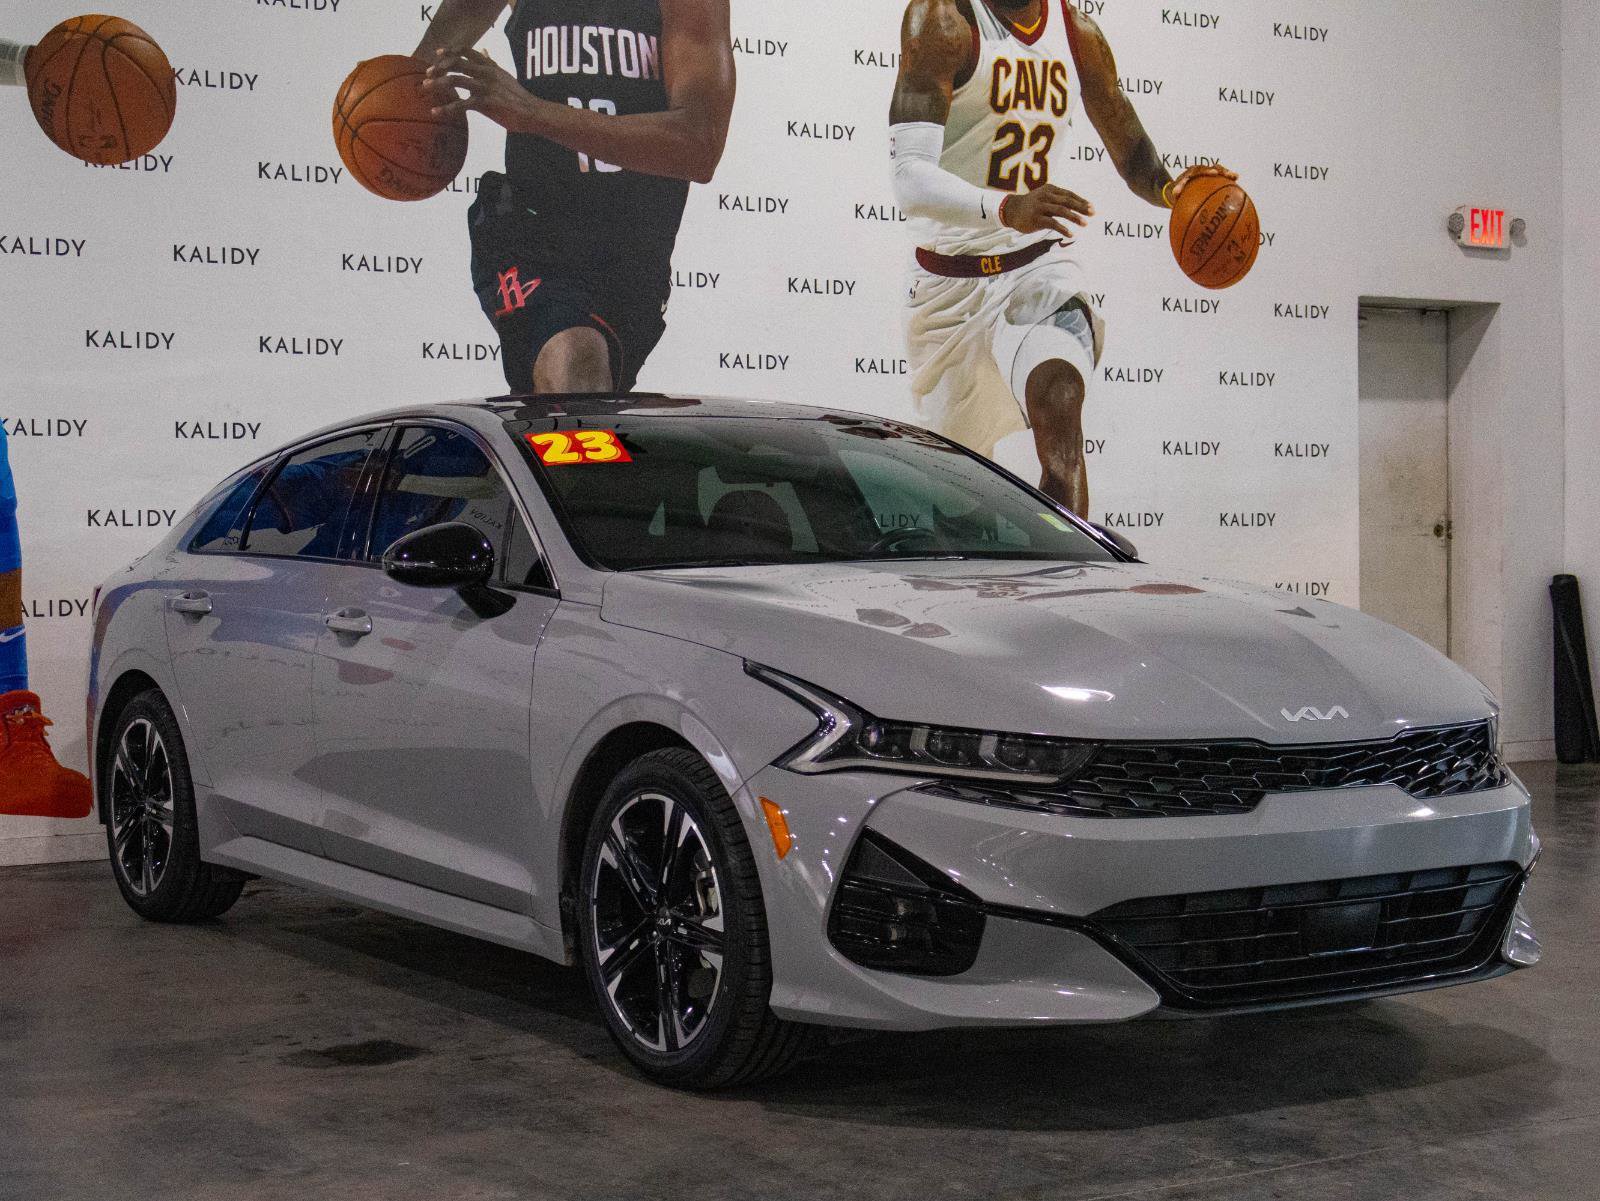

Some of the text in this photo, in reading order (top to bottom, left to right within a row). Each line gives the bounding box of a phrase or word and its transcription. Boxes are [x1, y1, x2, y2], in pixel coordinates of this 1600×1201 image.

[1162, 9, 1219, 29] KALIDY
[1274, 23, 1328, 42] KALIDY
[526, 25, 659, 80] HOUSTON
[733, 37, 787, 56] ALIDY
[855, 49, 901, 68] KALI
[175, 68, 258, 91] KALIDY
[990, 57, 1067, 117] CAVS
[1117, 78, 1162, 95] ALIDY
[1219, 88, 1274, 106] KALIDY
[788, 121, 855, 141] KALIDY
[986, 119, 1055, 192] 23
[259, 162, 342, 184] KALIDY
[1274, 163, 1328, 180] KALIDY
[719, 194, 788, 214] KALIDY
[1105, 222, 1163, 239] KALIDY
[1469, 208, 1504, 245] EXIT
[0, 236, 86, 256] KALIDY
[174, 244, 260, 265] KALIDY
[343, 254, 423, 273] KALIDY
[980, 254, 1001, 274] CLE
[788, 277, 855, 295] KALIDY
[1163, 297, 1219, 313] KALIDY
[1275, 304, 1329, 319] KALIDY
[86, 330, 175, 349] KALIDY
[260, 336, 343, 355] KALIDY
[423, 342, 500, 360] KALIDY
[720, 353, 789, 370] KALIDY
[856, 358, 906, 374] KALID
[1105, 367, 1163, 382] KALIDY
[1220, 371, 1275, 386] KALIDY
[176, 421, 261, 439] KALIDY
[531, 431, 622, 463] 23
[1163, 441, 1220, 455] KALIDY
[1275, 443, 1329, 457] KALIDY
[88, 510, 177, 527] KALIDY
[1105, 513, 1163, 527] KALIDY
[1220, 513, 1275, 526] KALIDY
[21, 599, 89, 617] ALIDY
